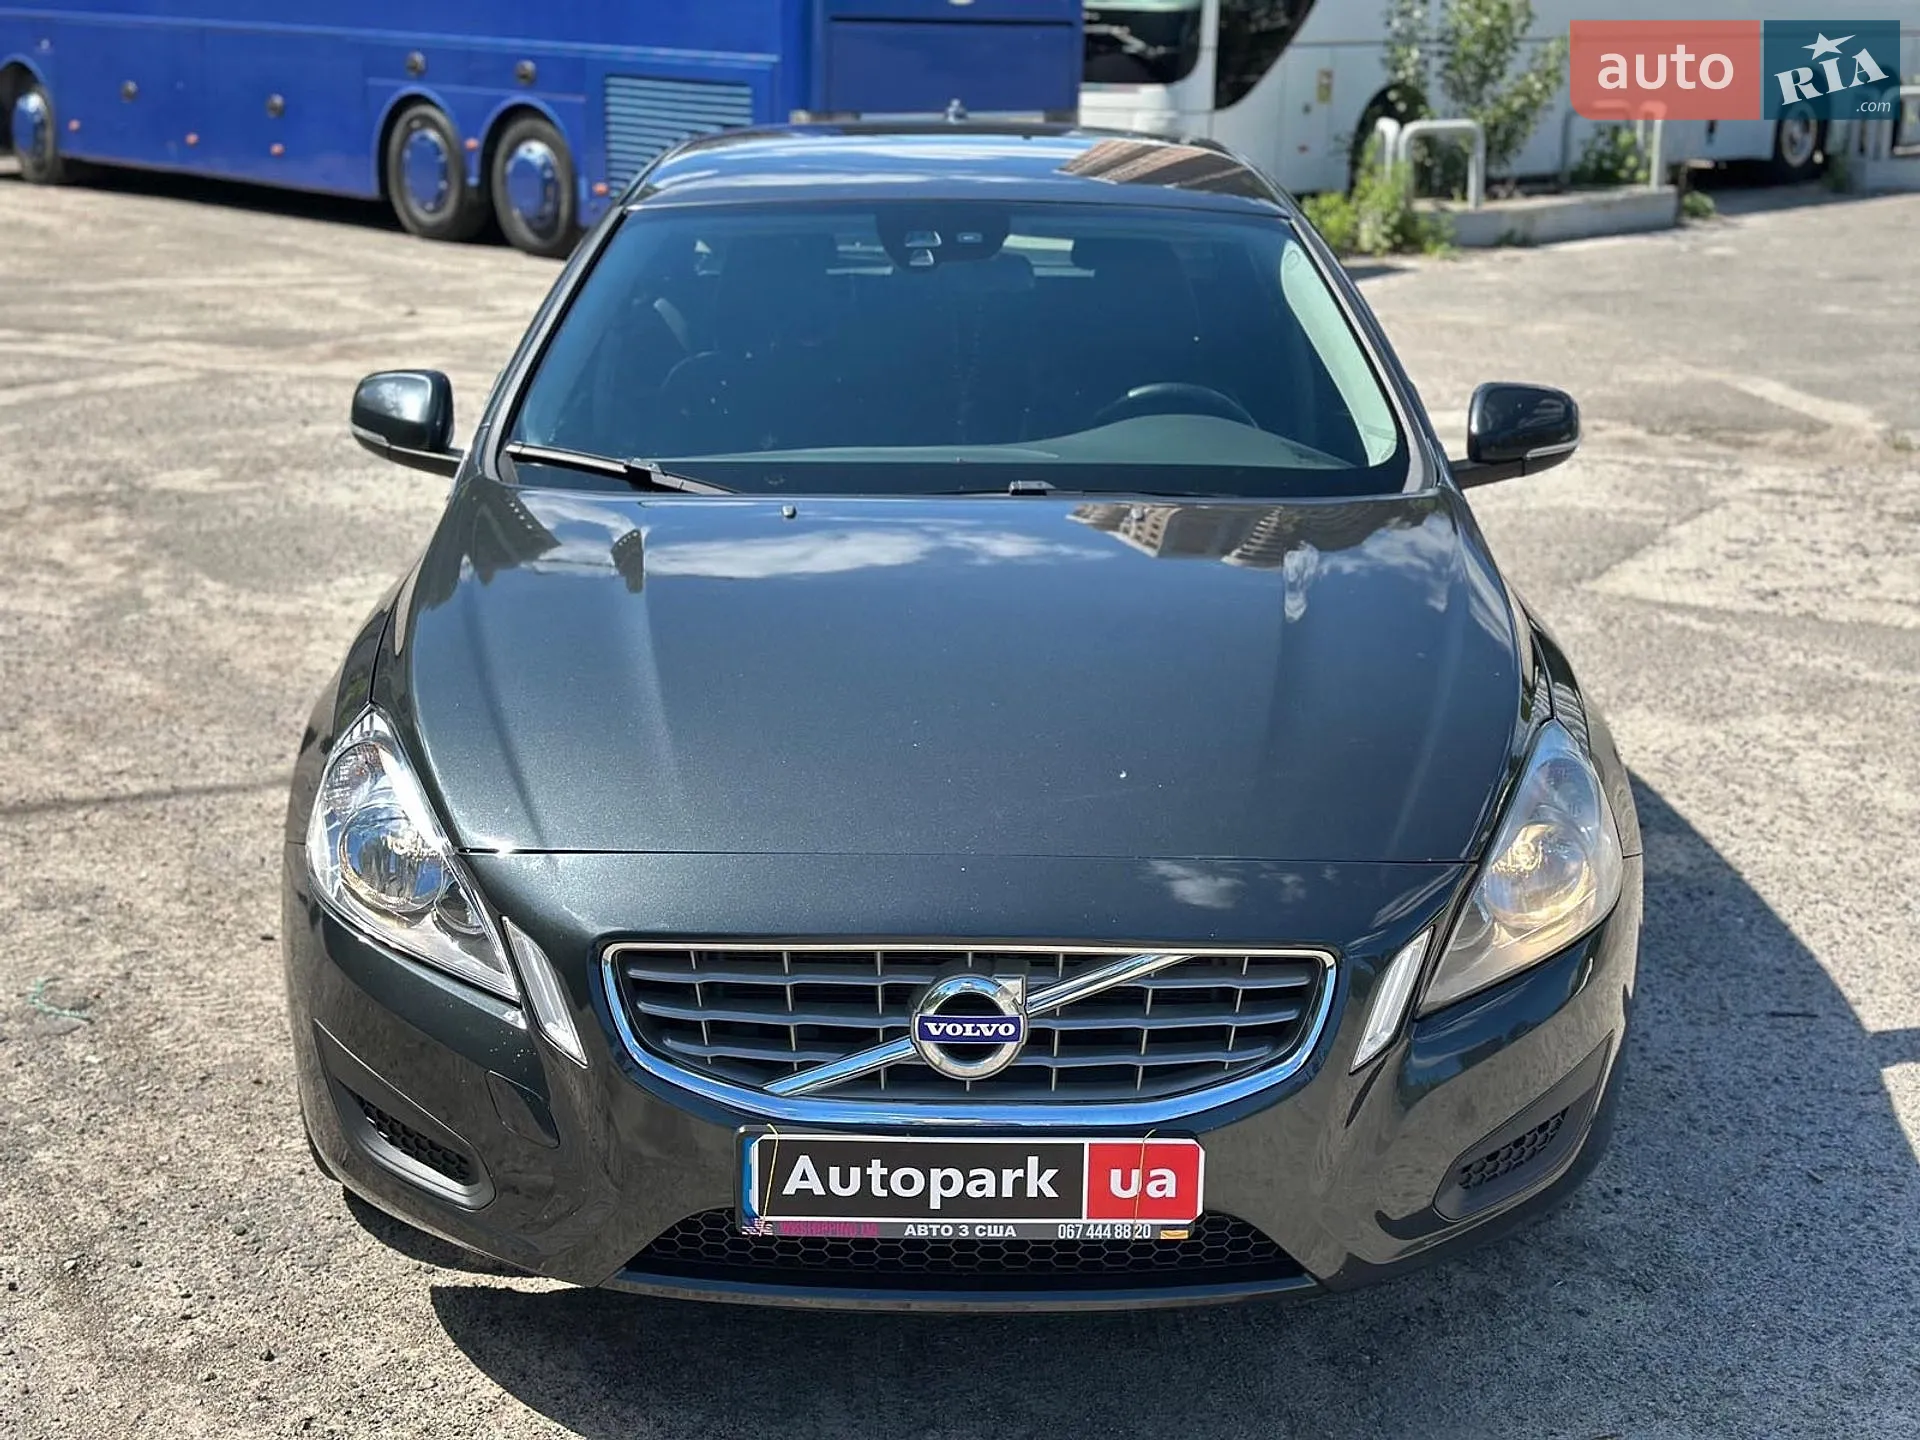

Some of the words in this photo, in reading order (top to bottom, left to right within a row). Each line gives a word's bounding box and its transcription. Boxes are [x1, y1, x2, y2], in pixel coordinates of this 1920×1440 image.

[924, 1022, 1016, 1037] VOLVO
[782, 1154, 1060, 1210] Autopark
[1109, 1167, 1177, 1199] ua
[904, 1224, 953, 1237] АВТО
[974, 1225, 1017, 1238] США
[1057, 1223, 1083, 1240] 067
[1085, 1223, 1112, 1240] 444
[1114, 1223, 1132, 1240] 88
[1134, 1223, 1152, 1240] 20
